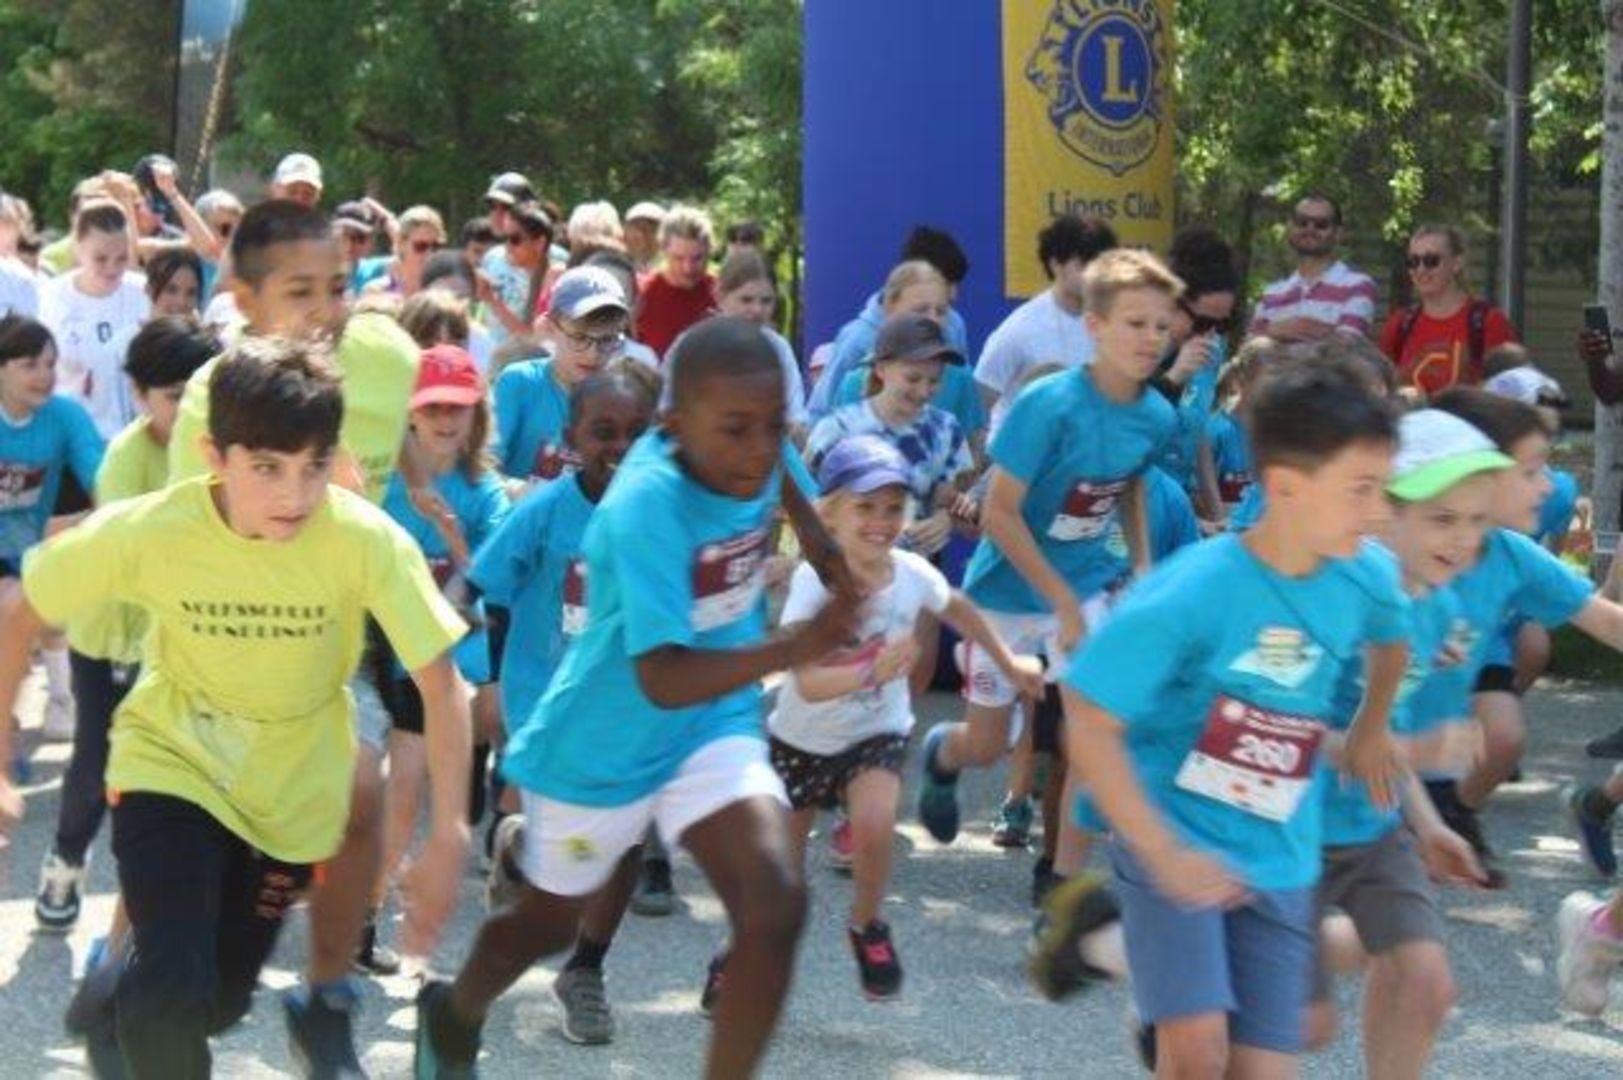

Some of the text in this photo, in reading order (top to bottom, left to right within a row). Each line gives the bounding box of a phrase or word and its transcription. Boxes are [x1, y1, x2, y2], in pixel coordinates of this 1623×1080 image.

[1102, 35, 1137, 102] L
[1048, 190, 1163, 219] Lions Club
